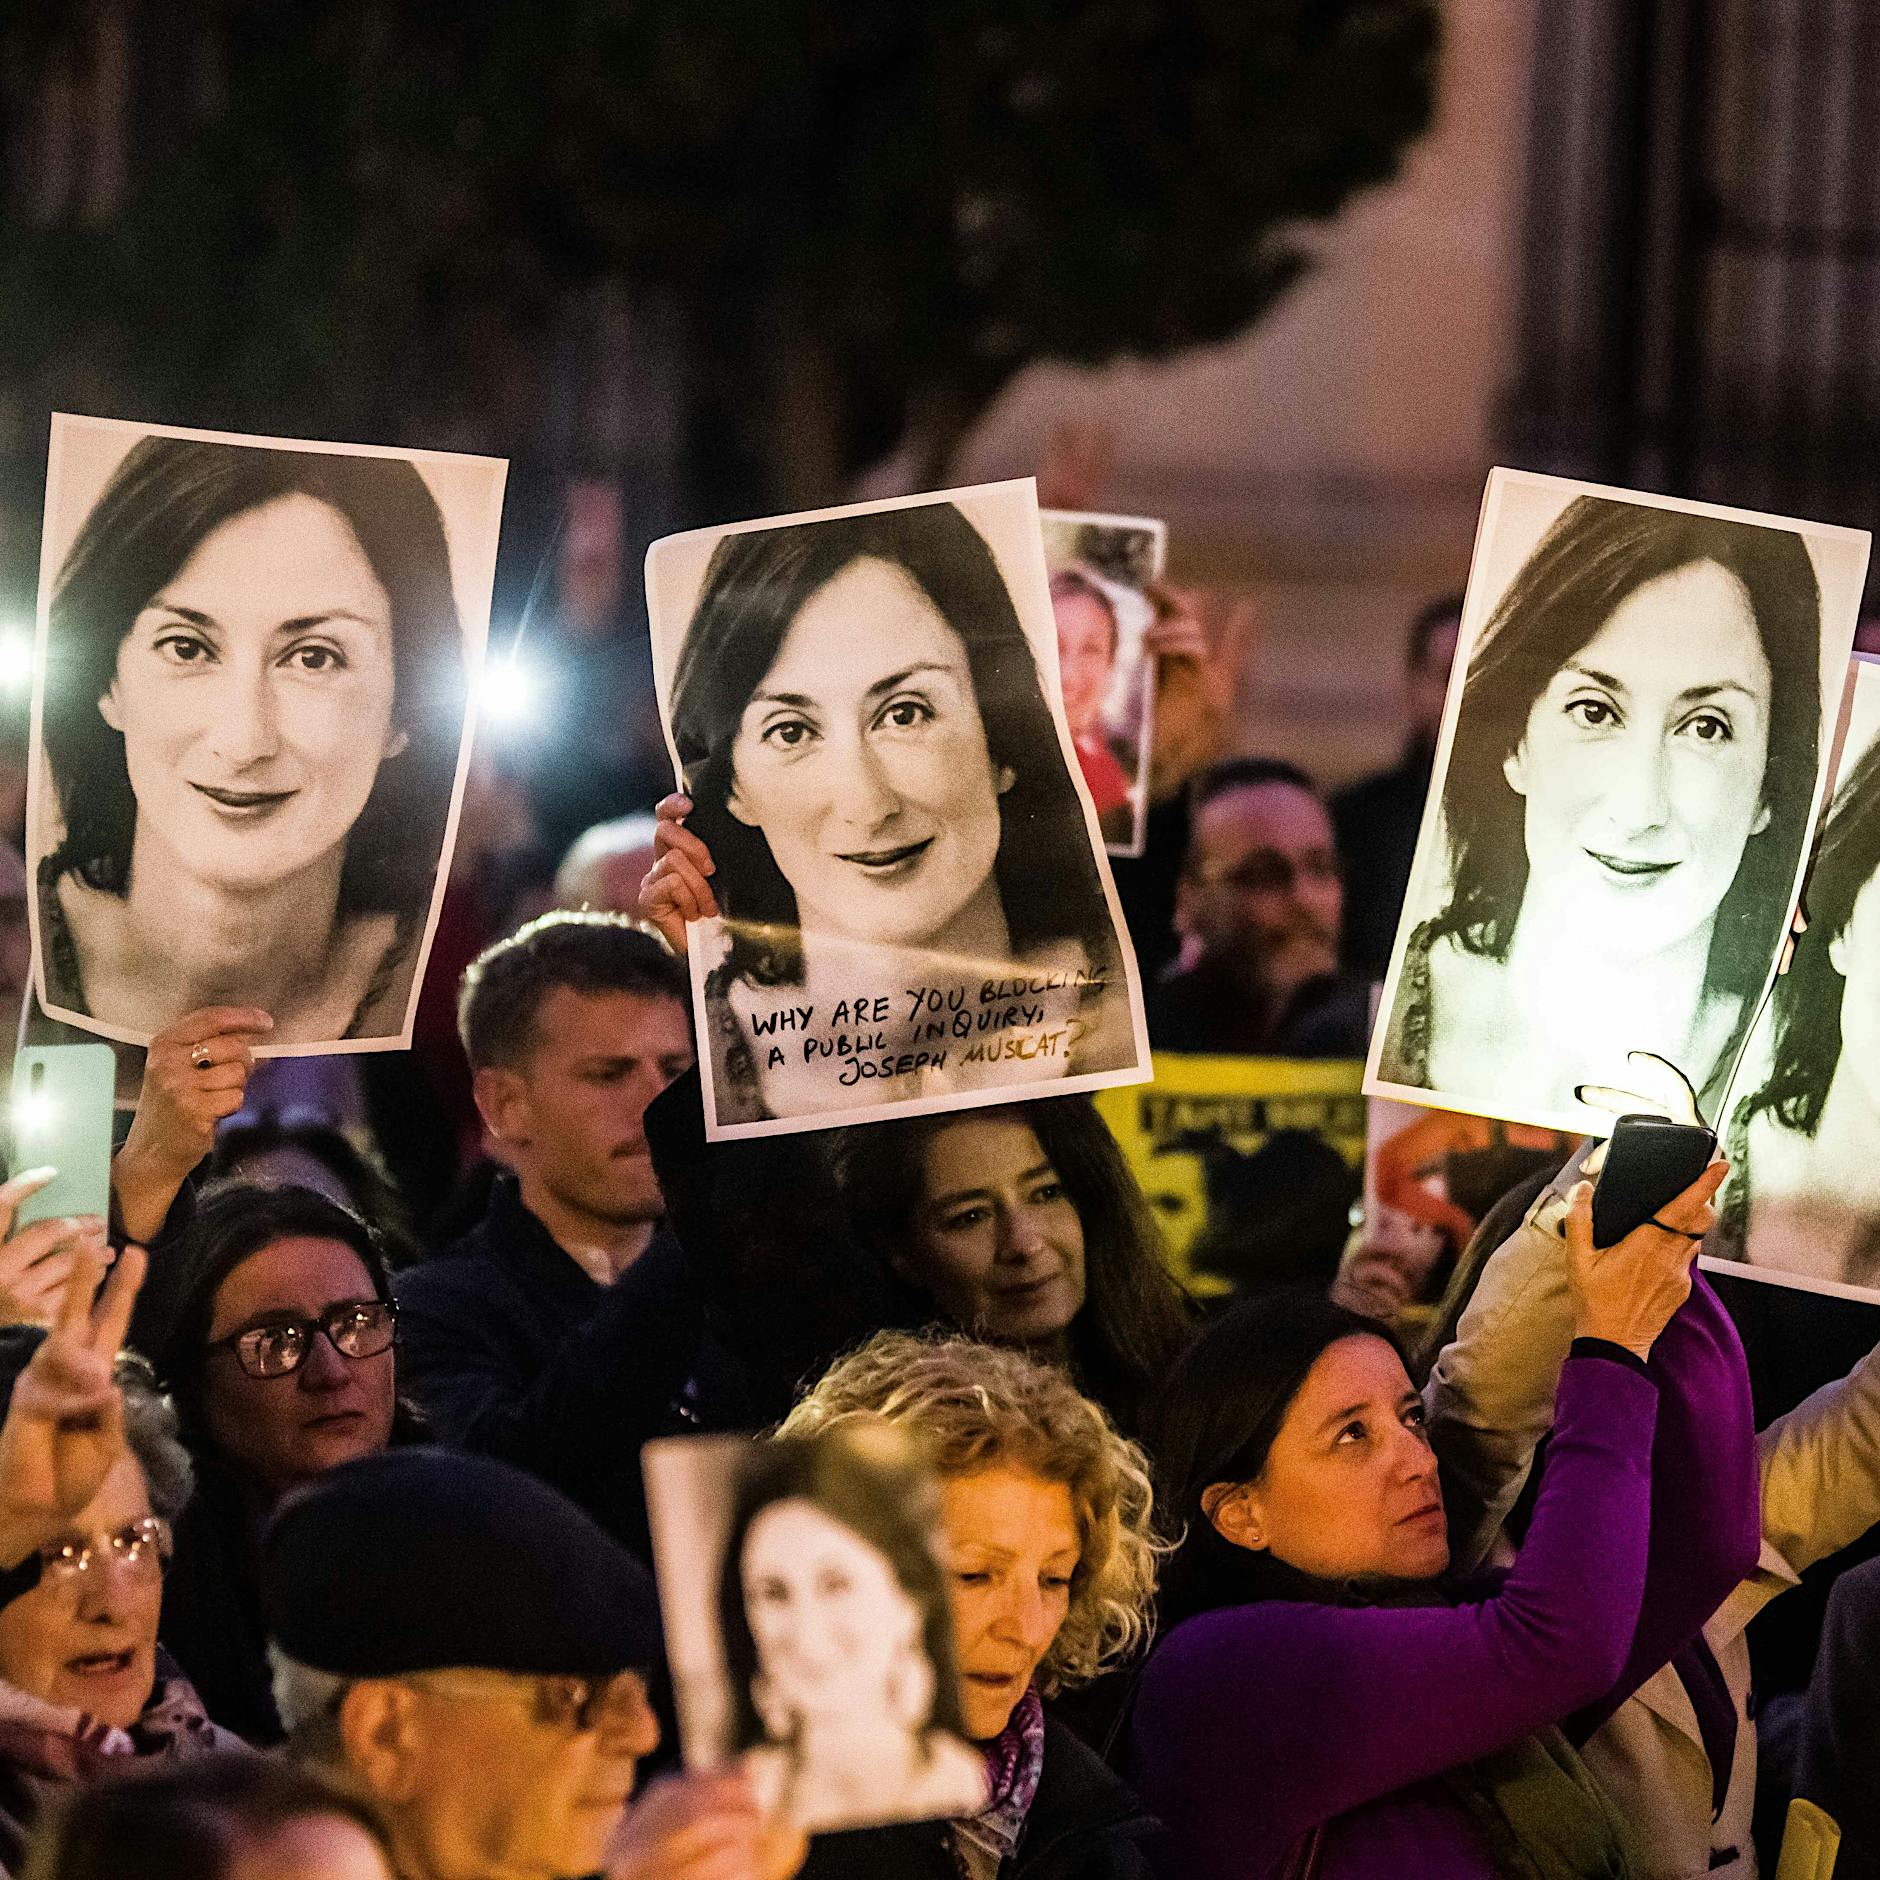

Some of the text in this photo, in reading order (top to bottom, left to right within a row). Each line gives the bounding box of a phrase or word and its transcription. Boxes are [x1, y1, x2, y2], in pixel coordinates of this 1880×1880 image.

[752, 964, 1107, 1037] WHY ARE YOU BLOCKING
[768, 1046, 785, 1070] A
[803, 1031, 887, 1064] PUBLIC
[838, 1018, 1087, 1086] JOSEPH MUSCAT?
